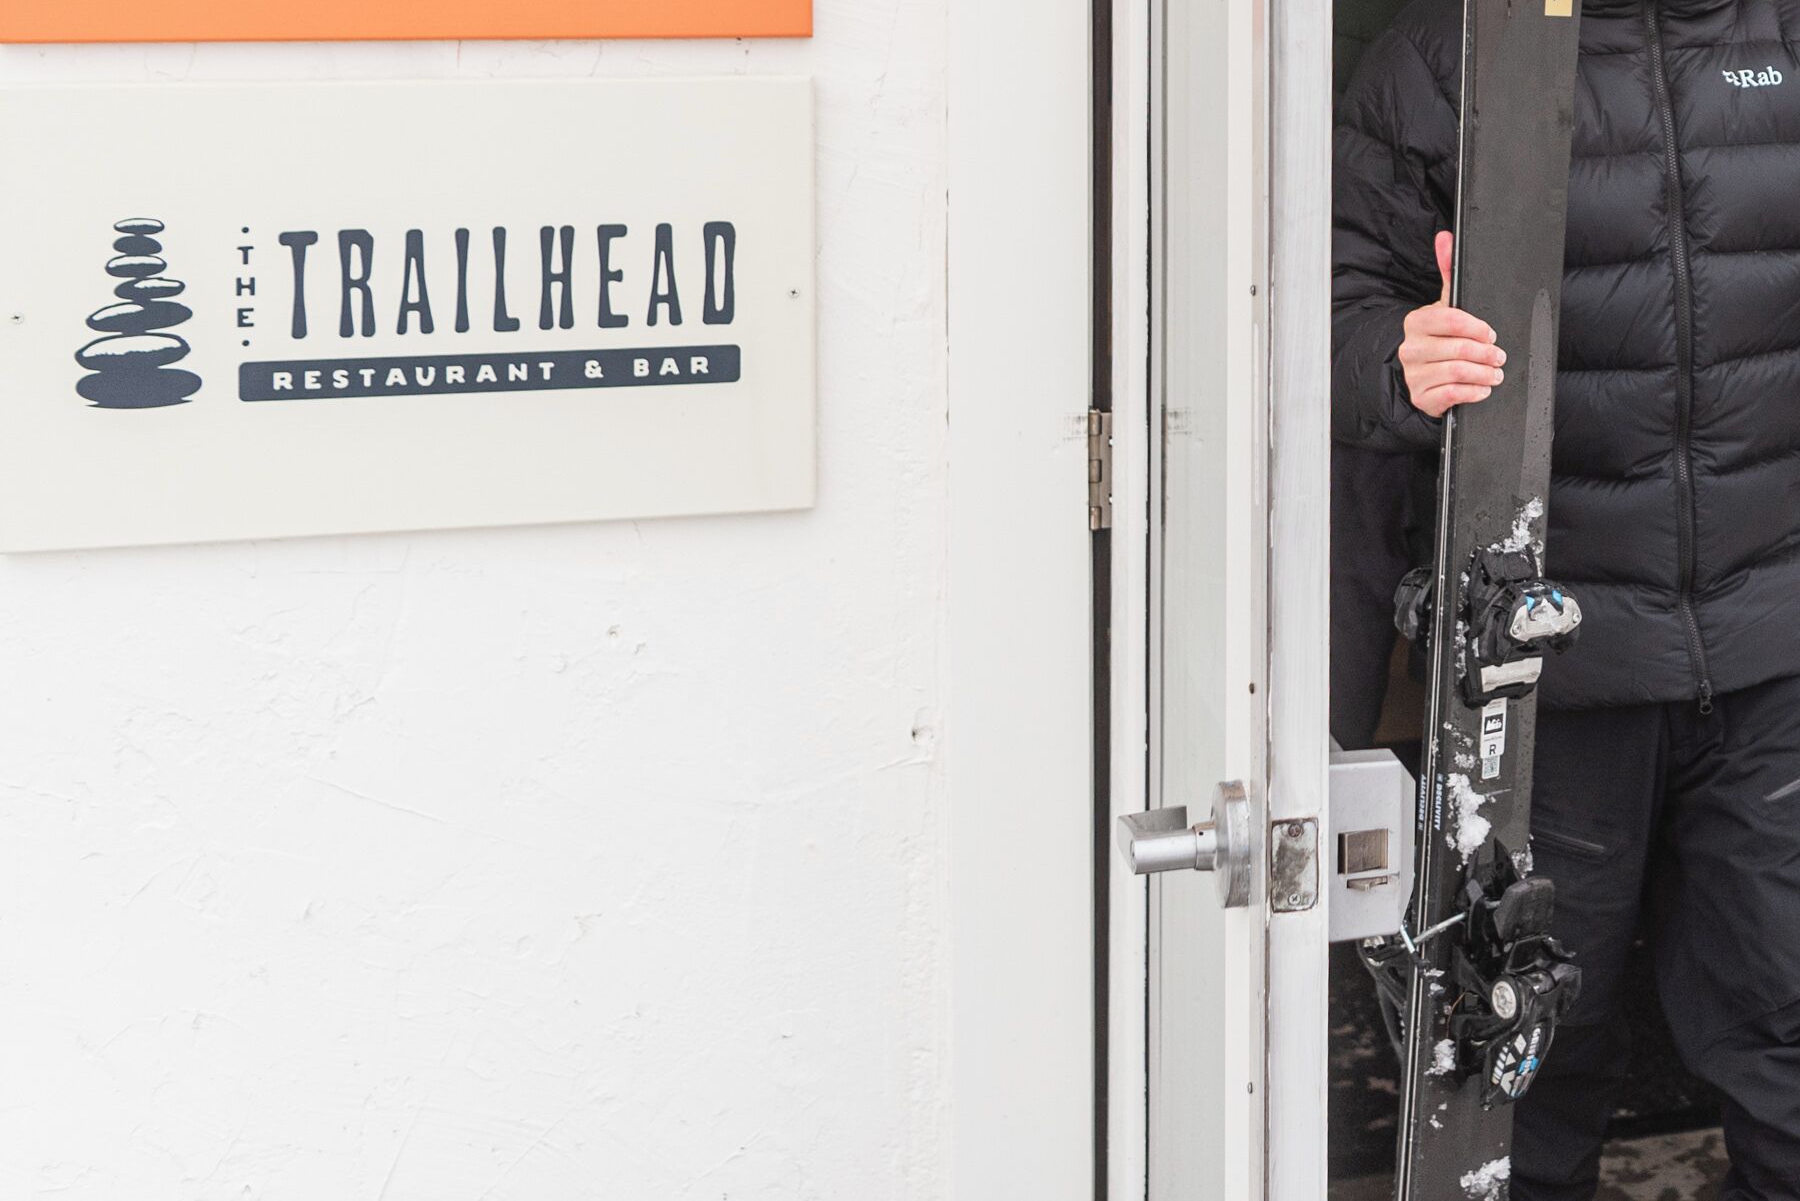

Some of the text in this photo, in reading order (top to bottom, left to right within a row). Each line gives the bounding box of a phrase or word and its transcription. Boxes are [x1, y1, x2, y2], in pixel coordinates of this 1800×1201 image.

[1737, 65, 1783, 88] Rab
[236, 245, 256, 328] THE
[278, 220, 736, 340] TRAILHEAD
[272, 356, 709, 391] RESTAURANT & BAR
[1434, 783, 1443, 831] DECLIVITY
